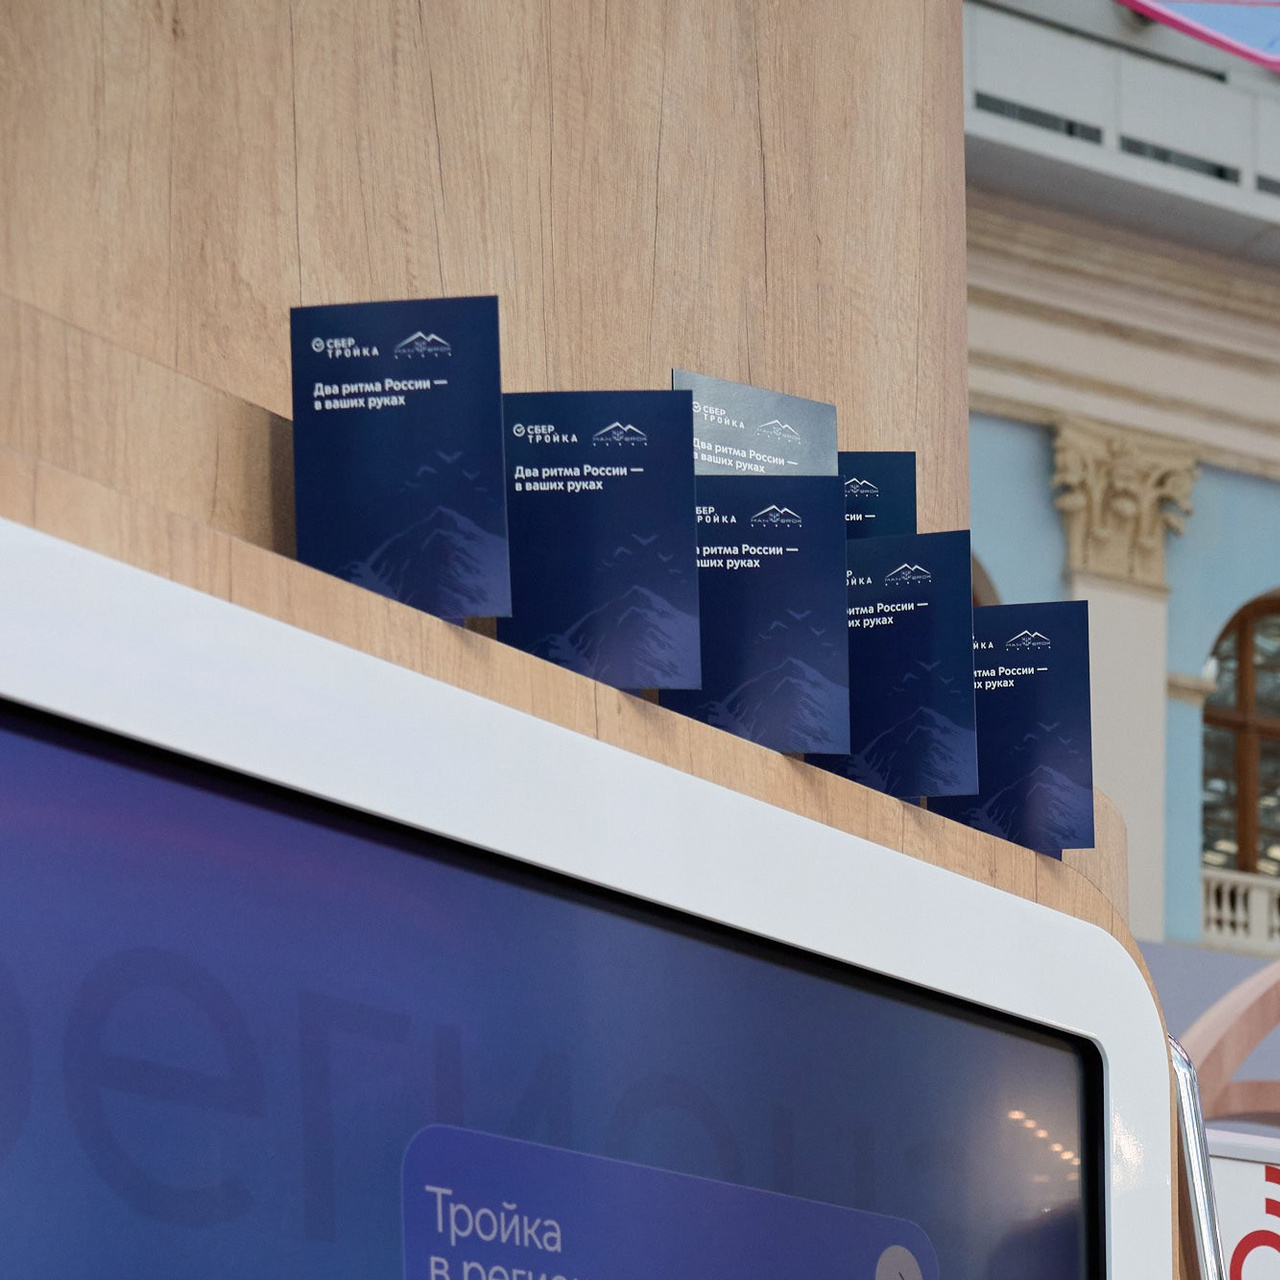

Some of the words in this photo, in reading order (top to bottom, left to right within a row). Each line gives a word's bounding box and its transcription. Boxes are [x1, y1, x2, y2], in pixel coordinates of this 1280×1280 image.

[326, 337, 355, 349] СБЕР
[327, 346, 380, 359] ТРОЙКА
[313, 382, 339, 397] Два
[342, 381, 382, 396] ритма
[384, 378, 430, 391] России
[314, 400, 322, 411] в
[325, 398, 365, 410] ваших
[367, 395, 406, 410] руках
[703, 405, 726, 416] СБЕР
[703, 413, 745, 429] ТРОЙКА
[527, 424, 555, 434] СБЕР
[528, 433, 578, 443] ТРОЙКА
[693, 437, 712, 451] Два
[714, 444, 747, 459] ритма
[749, 449, 785, 466] России
[701, 453, 734, 467] ваших
[735, 460, 765, 473] руках
[514, 466, 539, 480] Два
[542, 466, 580, 479] ритма
[583, 464, 627, 477] России
[515, 482, 522, 491] в
[525, 480, 564, 491] ваших
[567, 480, 603, 492] руках
[695, 506, 715, 515] БЕР
[697, 513, 737, 524] РОЙКА
[845, 513, 862, 521] сии
[703, 546, 739, 557] ритма
[742, 544, 783, 555] России
[696, 559, 724, 568] ших
[726, 559, 760, 570] руках
[847, 576, 873, 586] ЙКА
[877, 602, 915, 614] России
[863, 615, 894, 629] руках
[973, 641, 994, 650] ЙКА
[998, 666, 1035, 676] России
[985, 679, 1015, 690] руках
[425, 1184, 562, 1253] Тройка
